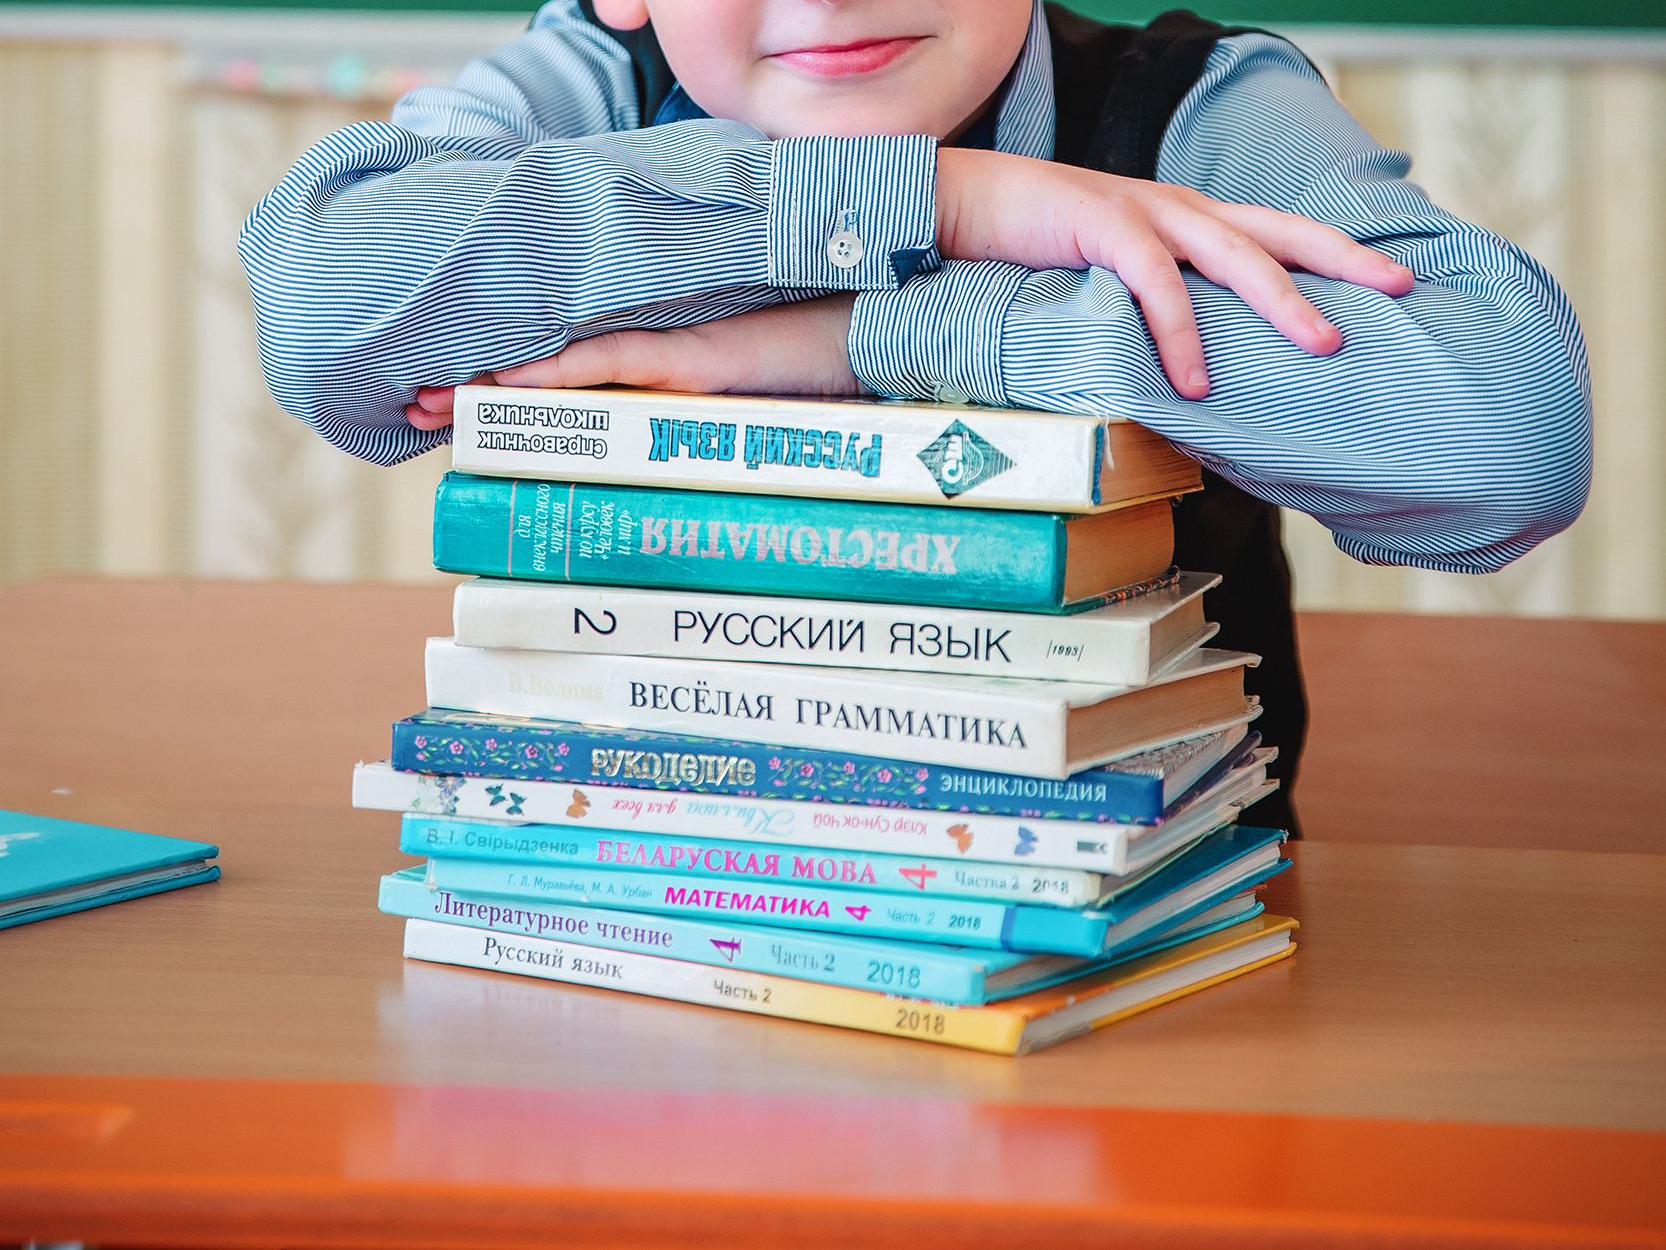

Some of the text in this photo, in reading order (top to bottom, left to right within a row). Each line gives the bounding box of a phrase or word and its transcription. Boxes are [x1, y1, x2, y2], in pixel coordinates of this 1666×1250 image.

[513, 514, 532, 538] для
[532, 483, 551, 572] внеклассного
[550, 502, 566, 554] чтения
[579, 500, 601, 559] по курсу
[639, 516, 961, 575] ХРЕСТОМАТИЯ
[573, 607, 618, 637] 2
[673, 608, 866, 654] РУССКИЙ
[888, 622, 1013, 664] ЯЗЫК
[628, 680, 775, 722] ВЕСЁЛАЯ
[794, 697, 1030, 751] ГРАММАТИКА
[612, 798, 642, 820] всех
[646, 797, 679, 815] для
[937, 771, 1108, 803] ЭНЦИКЛОПЕДИЯ
[425, 827, 444, 845] В.
[595, 839, 781, 876] БЕЛАРУСКАЯ
[790, 854, 879, 886] МОВА
[898, 864, 937, 891] 4
[954, 870, 1008, 890] Частка
[664, 886, 831, 919] МАТЕМАТИКА
[845, 903, 872, 922] 4
[887, 907, 921, 925] Часть
[926, 912, 936, 926] 2
[948, 914, 981, 930] 2018
[434, 891, 922, 990] Литературное чтение 4 Часть 2 2018
[482, 936, 946, 1035] Русский язык Часть 2 2018
